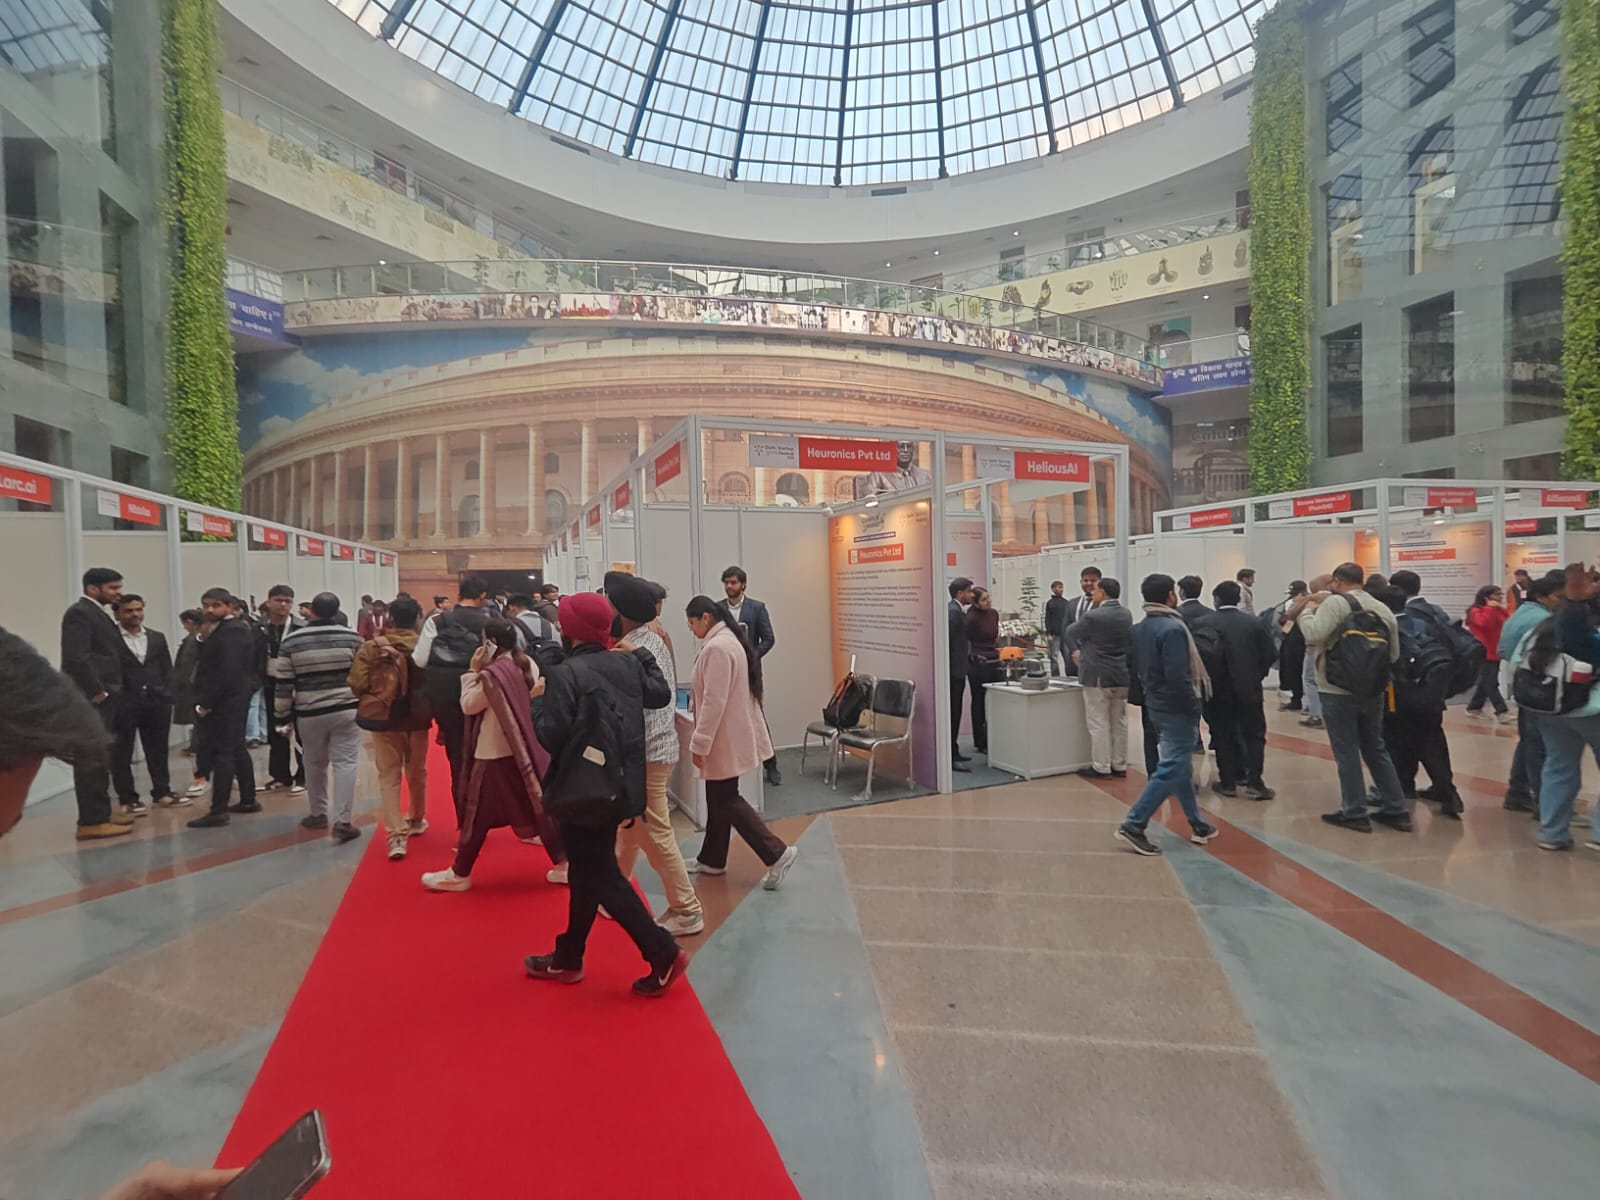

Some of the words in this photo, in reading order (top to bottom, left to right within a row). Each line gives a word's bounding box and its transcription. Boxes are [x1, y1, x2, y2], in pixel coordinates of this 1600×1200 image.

[807, 447, 856, 459] Heuronics
[858, 449, 874, 460] Pvt
[875, 450, 891, 461] Ltd
[1027, 460, 1078, 475] HeliousAI
